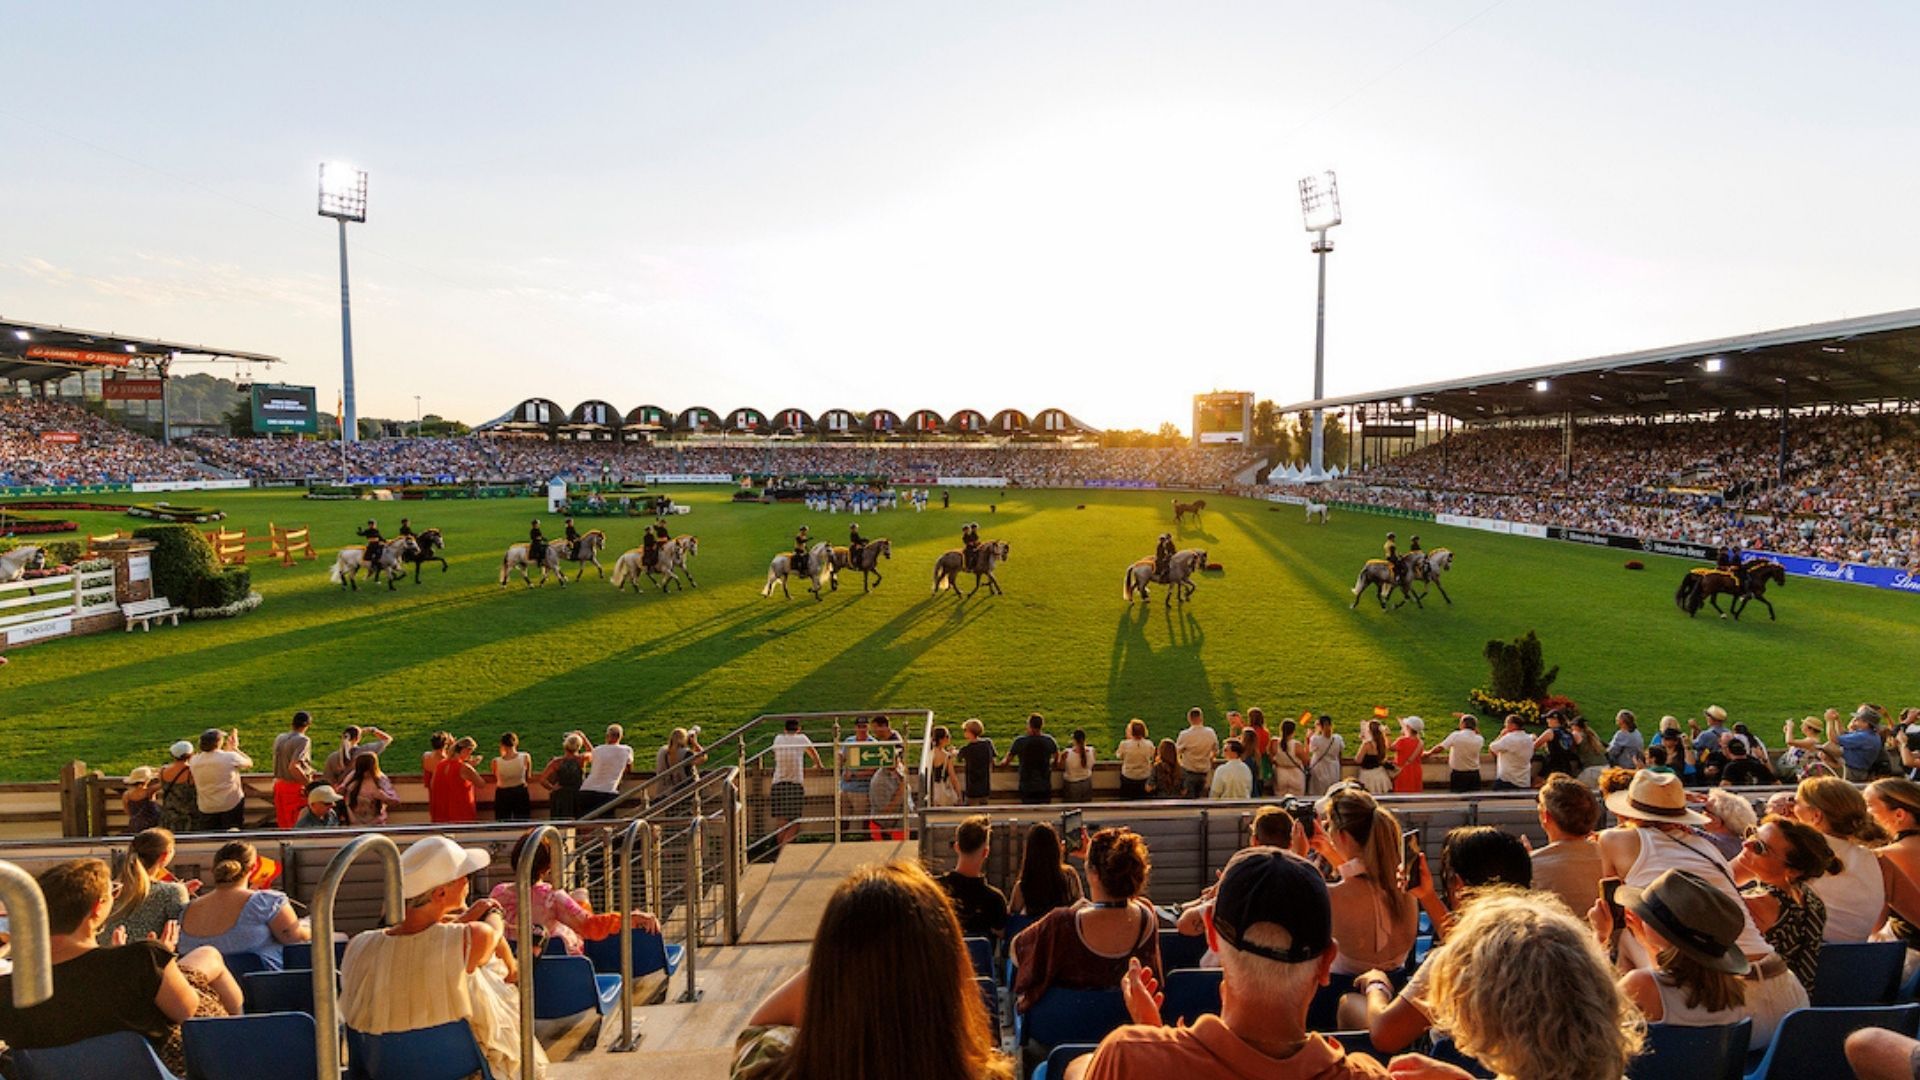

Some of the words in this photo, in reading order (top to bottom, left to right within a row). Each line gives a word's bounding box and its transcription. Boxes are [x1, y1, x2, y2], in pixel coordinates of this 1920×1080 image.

[119, 385, 161, 393] STAWAG
[1654, 543, 1705, 558] Mercedes-Benz
[1808, 563, 1845, 578] Lindt
